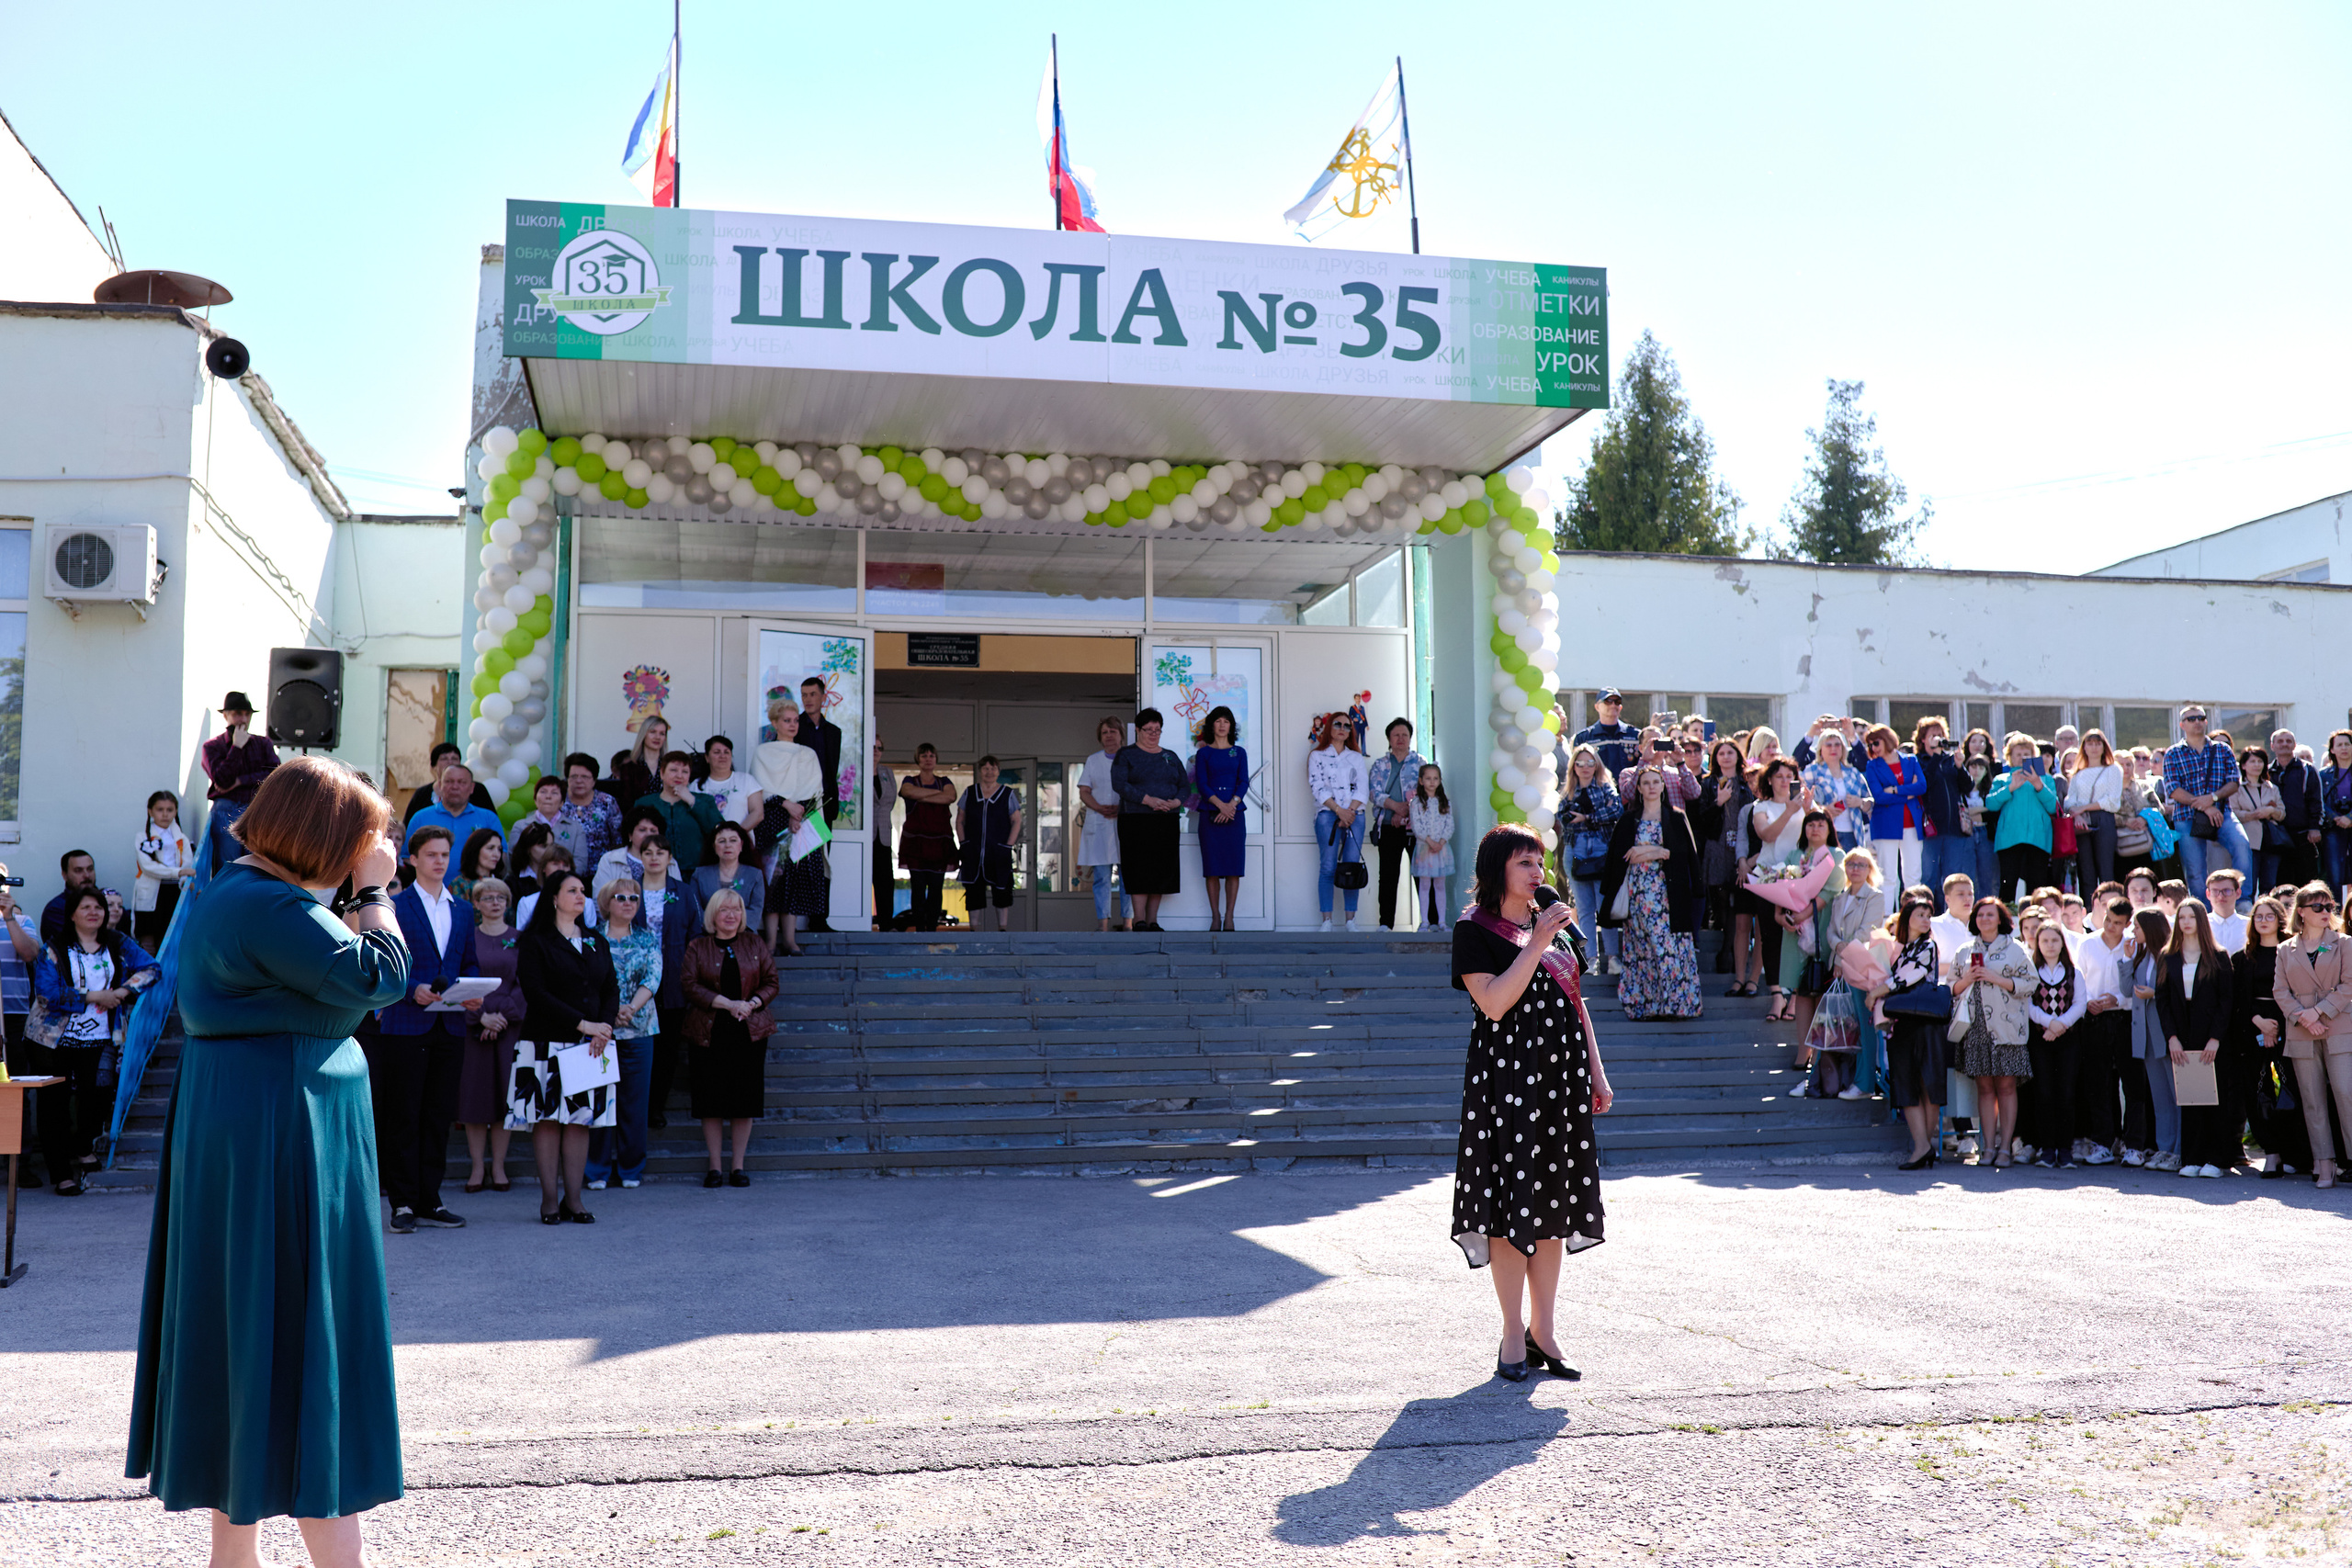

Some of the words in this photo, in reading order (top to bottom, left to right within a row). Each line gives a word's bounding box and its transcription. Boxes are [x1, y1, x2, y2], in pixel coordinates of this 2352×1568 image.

[515, 214, 566, 228] ШКОЛА
[713, 227, 761, 239] ШКОЛА
[771, 227, 834, 244] УЧЕБА
[665, 254, 718, 267] ШКОЛА
[1124, 244, 1182, 263] УЧЕБА
[1255, 256, 1310, 271] ШКОЛА
[1316, 257, 1388, 276] ДРУЗЬЯ
[1403, 267, 1426, 277] УРОК
[1434, 267, 1477, 280] ШКОЛА
[1486, 268, 1542, 287] УЧЕБА
[1553, 276, 1600, 287] КАНИКУЛЫ
[514, 275, 547, 287] УРОК
[578, 260, 628, 295] 35
[572, 299, 636, 310] ШКОЛА
[731, 244, 1188, 347] ШКОЛА
[1216, 289, 1318, 355] №
[1339, 281, 1442, 362] 35
[1488, 289, 1600, 316] ОТМЕТКИ
[513, 331, 612, 346] ОБРАЗОВАНИЕ
[623, 333, 676, 348] ШКОЛА
[731, 336, 794, 355] УЧЕБА
[1473, 322, 1600, 345] ОБРАЗОВАНИЕ
[1124, 355, 1182, 373] УЧЕБА
[1255, 365, 1310, 380] ШКОЛА
[1316, 366, 1388, 384] ДРУЗЬЯ
[1404, 375, 1426, 384] УРОК
[1435, 375, 1478, 387] ШКОЛА
[1487, 375, 1543, 393] УЧЕБА
[1554, 382, 1600, 392] КАНИКУЛЫ
[1536, 351, 1600, 375] УРОК
